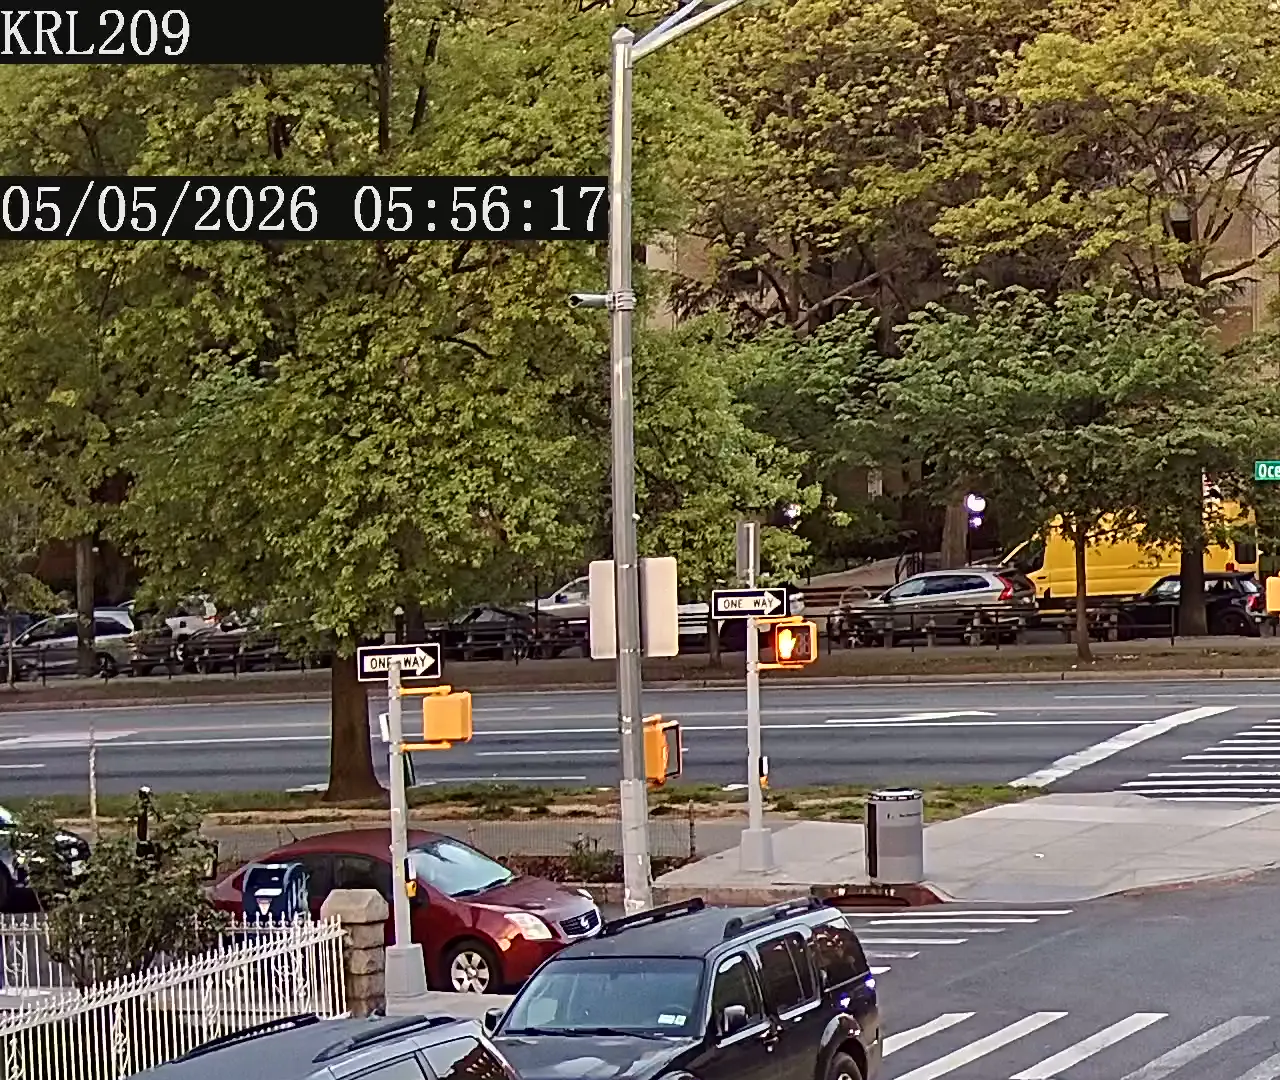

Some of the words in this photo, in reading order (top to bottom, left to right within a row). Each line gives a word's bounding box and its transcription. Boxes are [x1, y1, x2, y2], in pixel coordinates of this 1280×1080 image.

[723, 599, 743, 609] ONE
[753, 598, 774, 608] WAY
[403, 655, 426, 668] WAY
